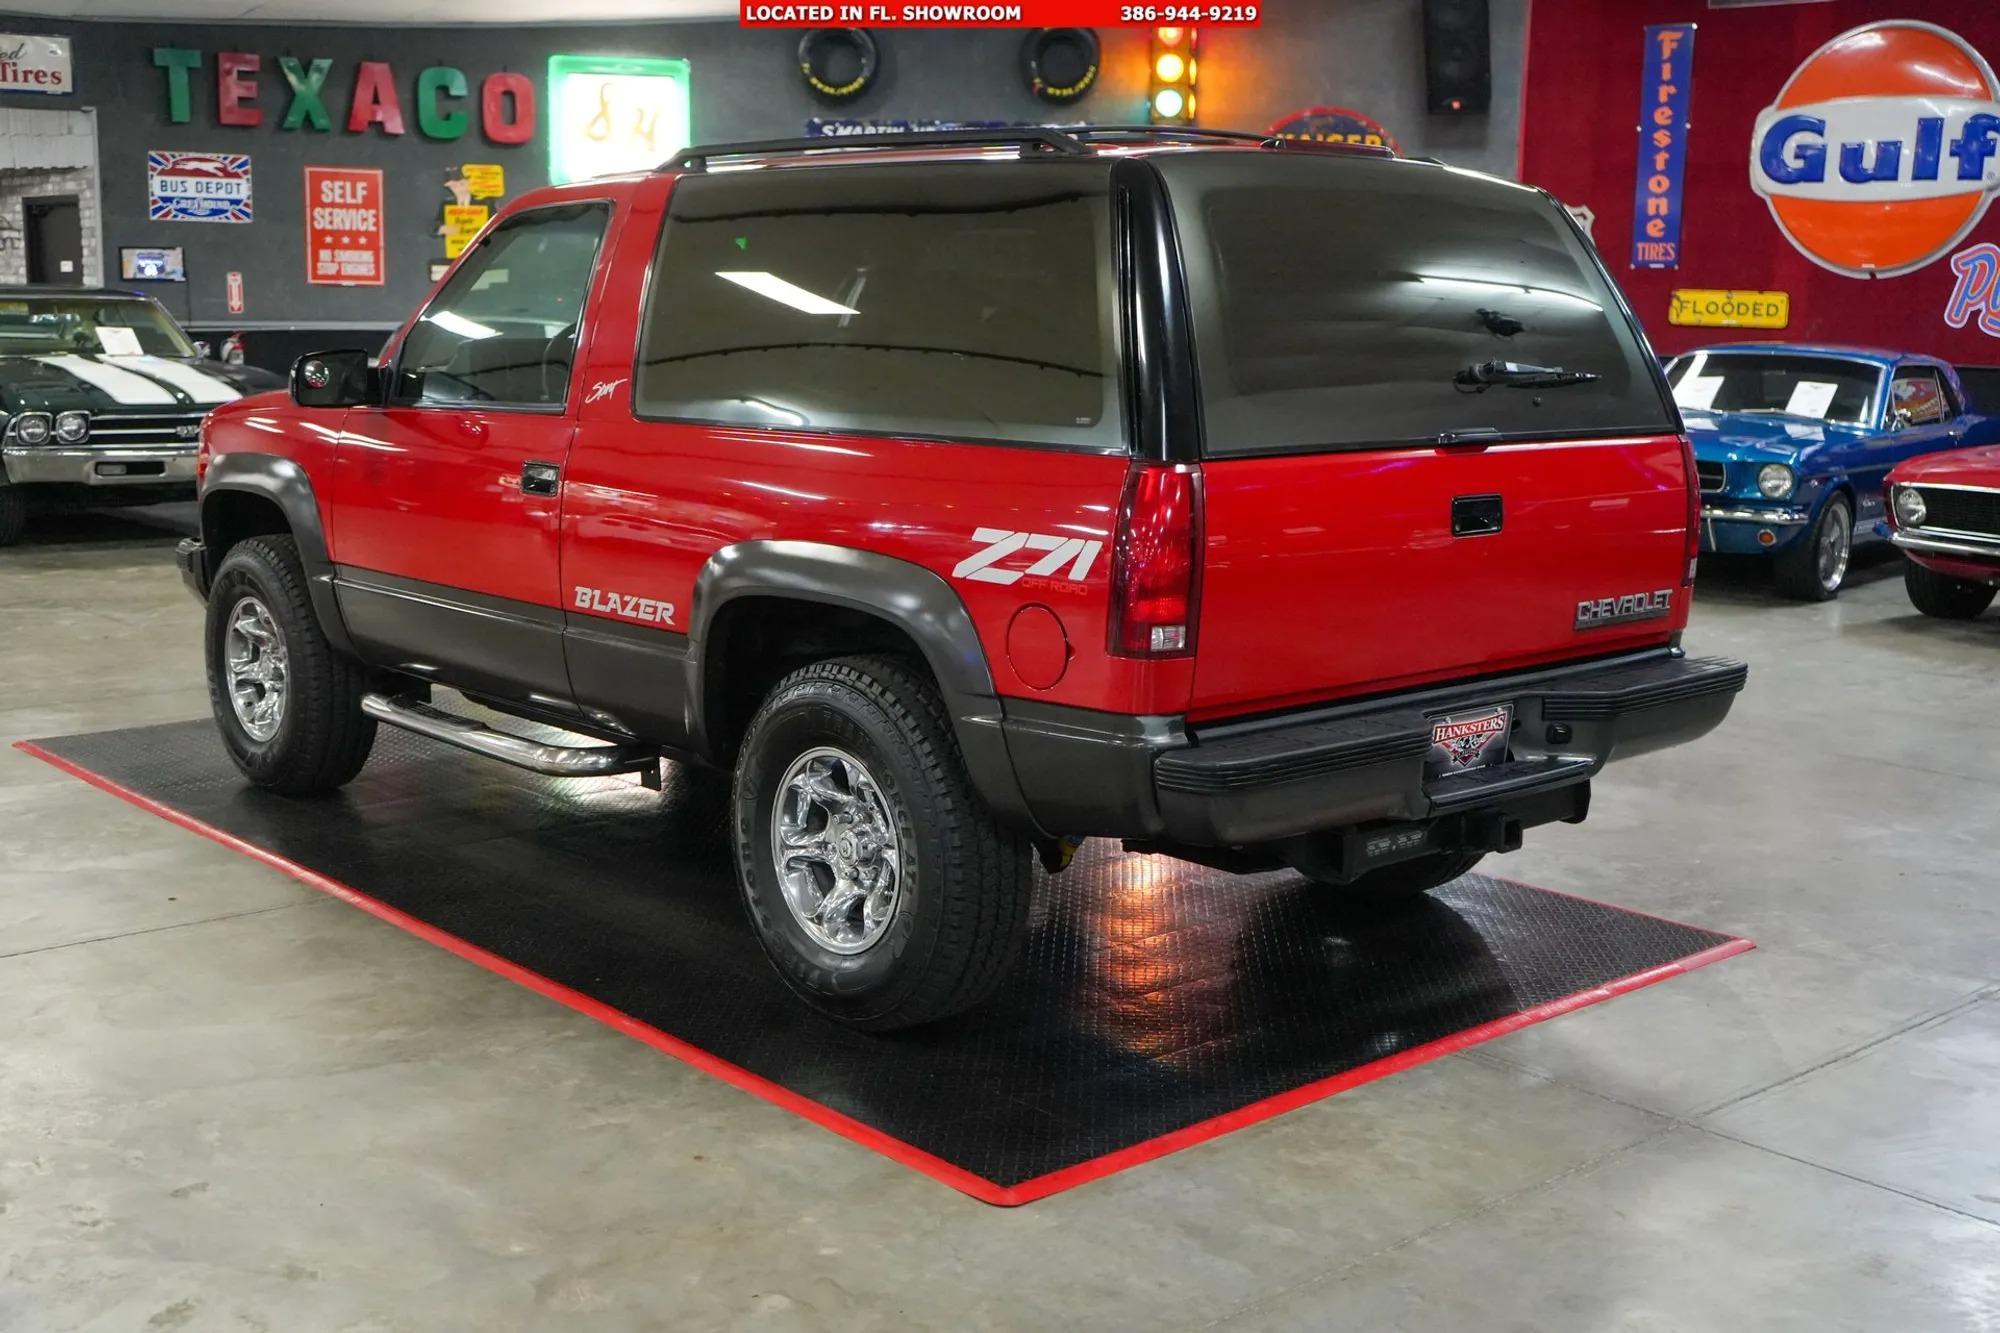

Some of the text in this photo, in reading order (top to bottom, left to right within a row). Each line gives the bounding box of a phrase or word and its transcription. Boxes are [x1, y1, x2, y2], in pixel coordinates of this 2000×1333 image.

[0, 61, 62, 85] Tires
[154, 48, 535, 144] TEXACO
[1646, 30, 1684, 238] Firestone
[1760, 113, 2000, 185] Gulf
[160, 179, 243, 195] BUS DEPOT
[320, 180, 368, 204] SELF
[313, 207, 377, 232] SERVICE
[1636, 241, 1676, 262] TIRES
[1679, 299, 1780, 318] FLOODED
[951, 526, 1104, 586] Z71
[1022, 576, 1088, 597] OFF ROAD
[573, 585, 676, 626] BLAZER
[1577, 588, 1674, 621] CHEVROLET
[1434, 714, 1506, 743] HANKSTERS
